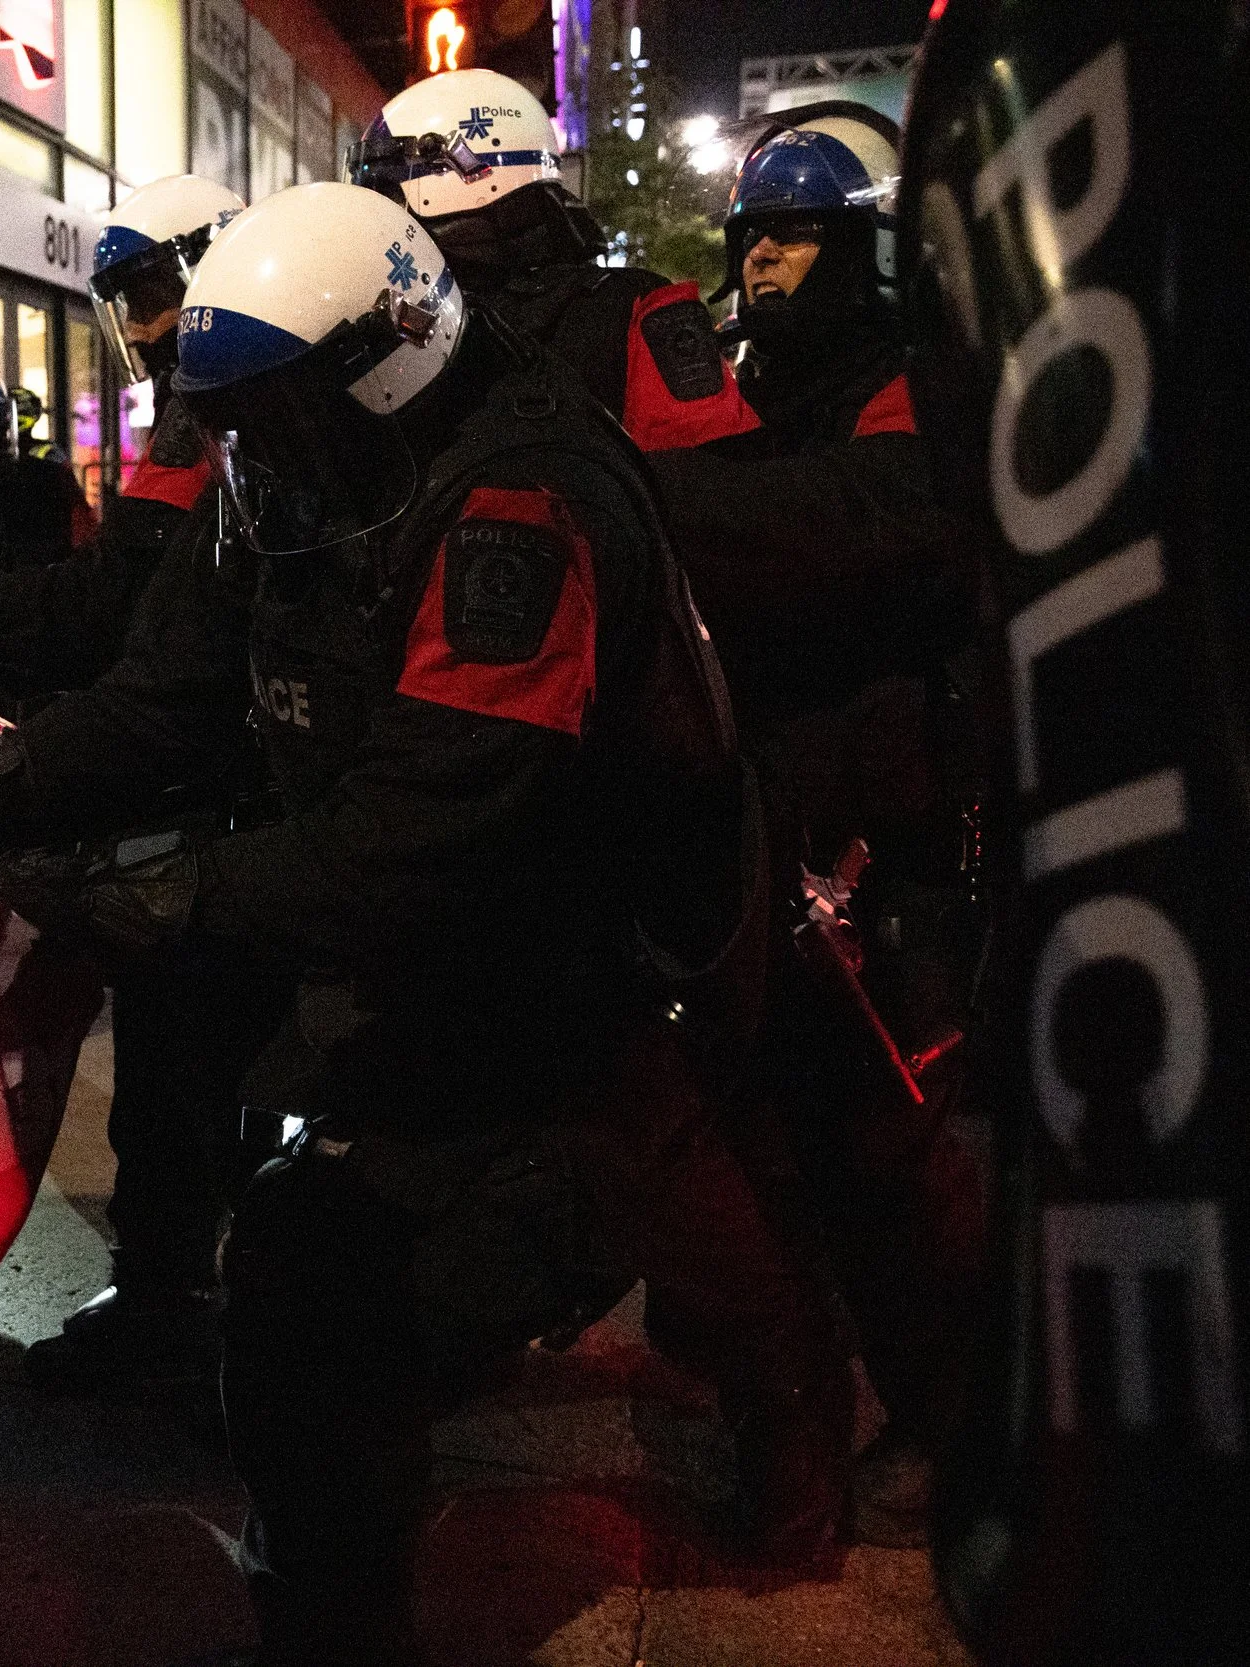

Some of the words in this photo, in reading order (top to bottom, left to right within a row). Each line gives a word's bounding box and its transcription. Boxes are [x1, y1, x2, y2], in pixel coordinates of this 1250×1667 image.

[482, 106, 522, 118] Police
[44, 214, 81, 275] 801
[972, 39, 1242, 1458] POLICE
